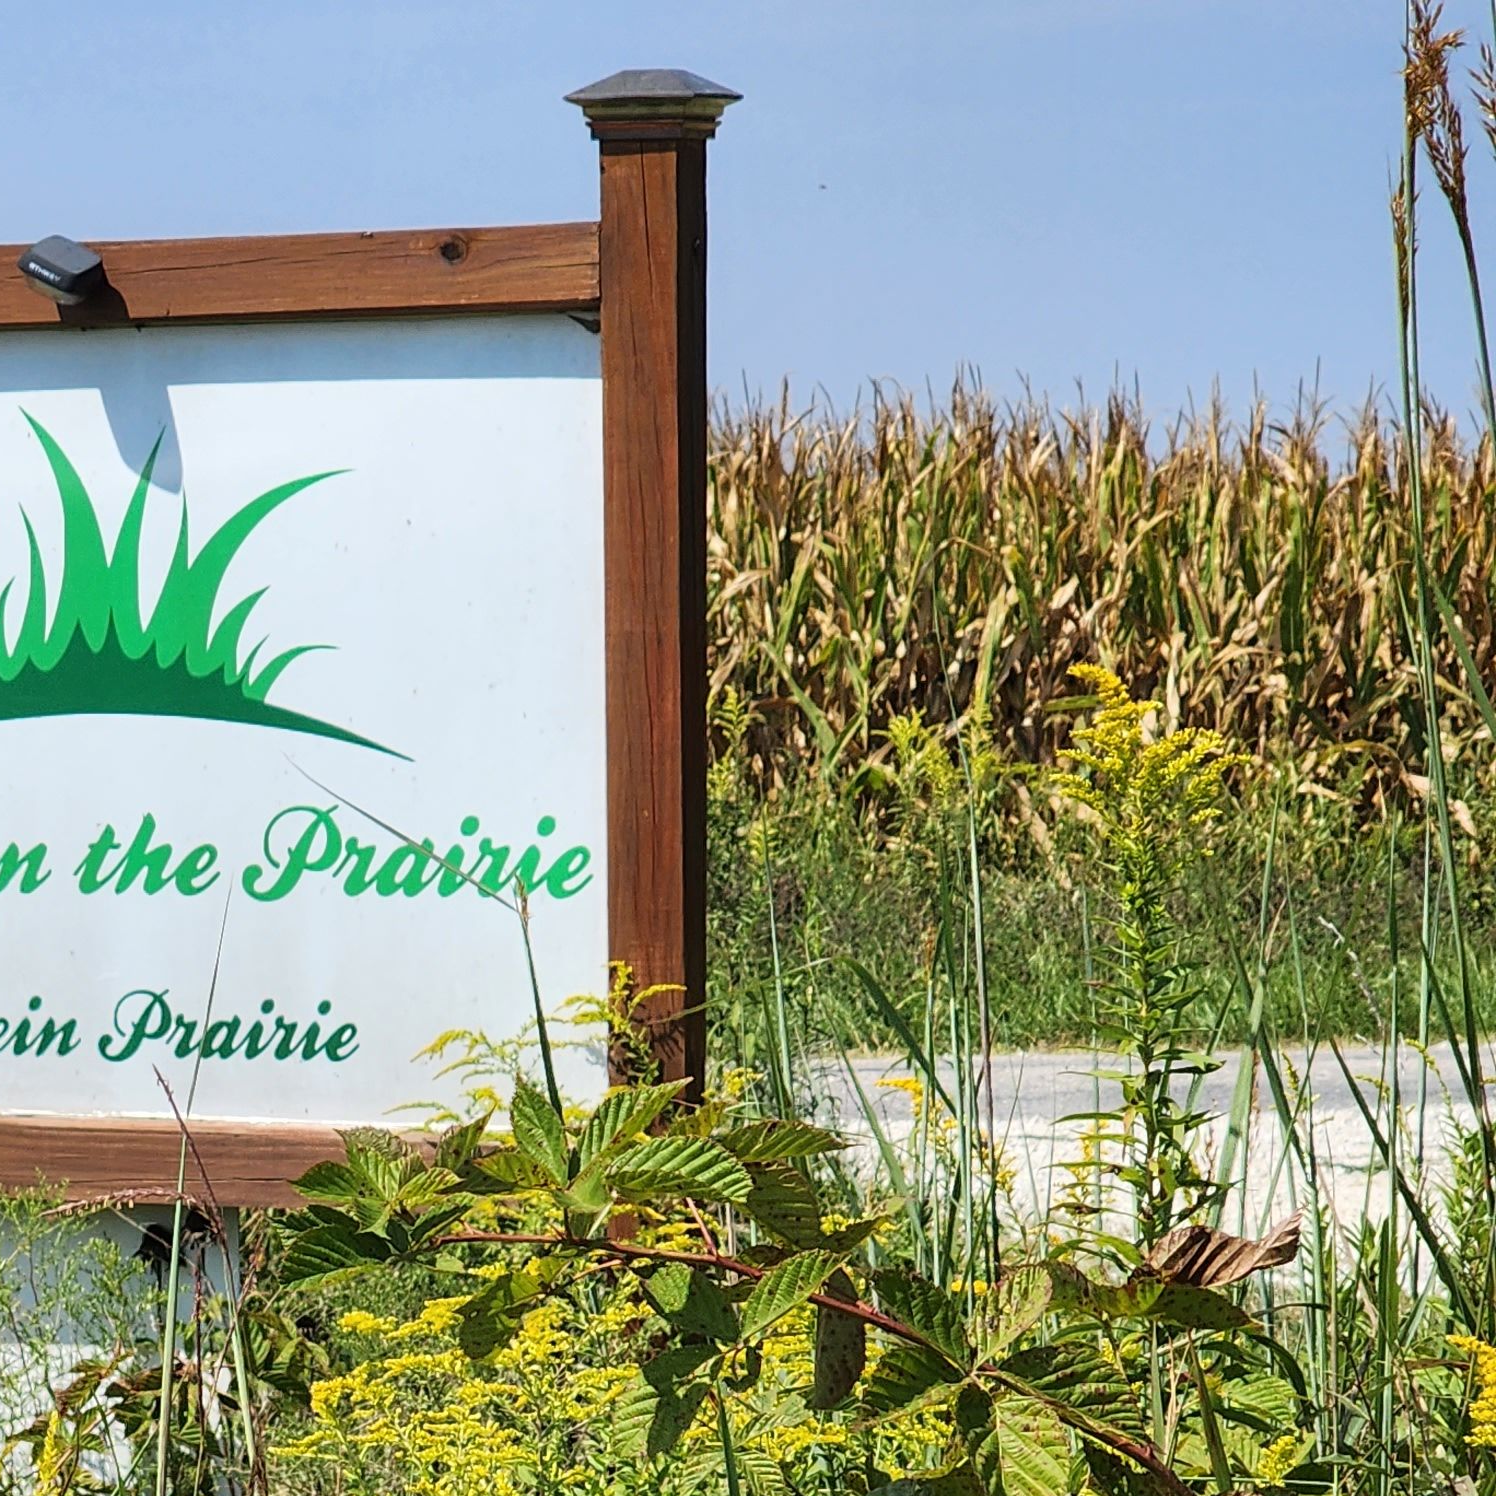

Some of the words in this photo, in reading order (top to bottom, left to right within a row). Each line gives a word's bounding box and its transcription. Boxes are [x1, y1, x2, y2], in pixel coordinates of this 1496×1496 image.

[75, 813, 220, 898] the
[242, 805, 594, 901] Prairie
[97, 989, 359, 1062] Prairie
